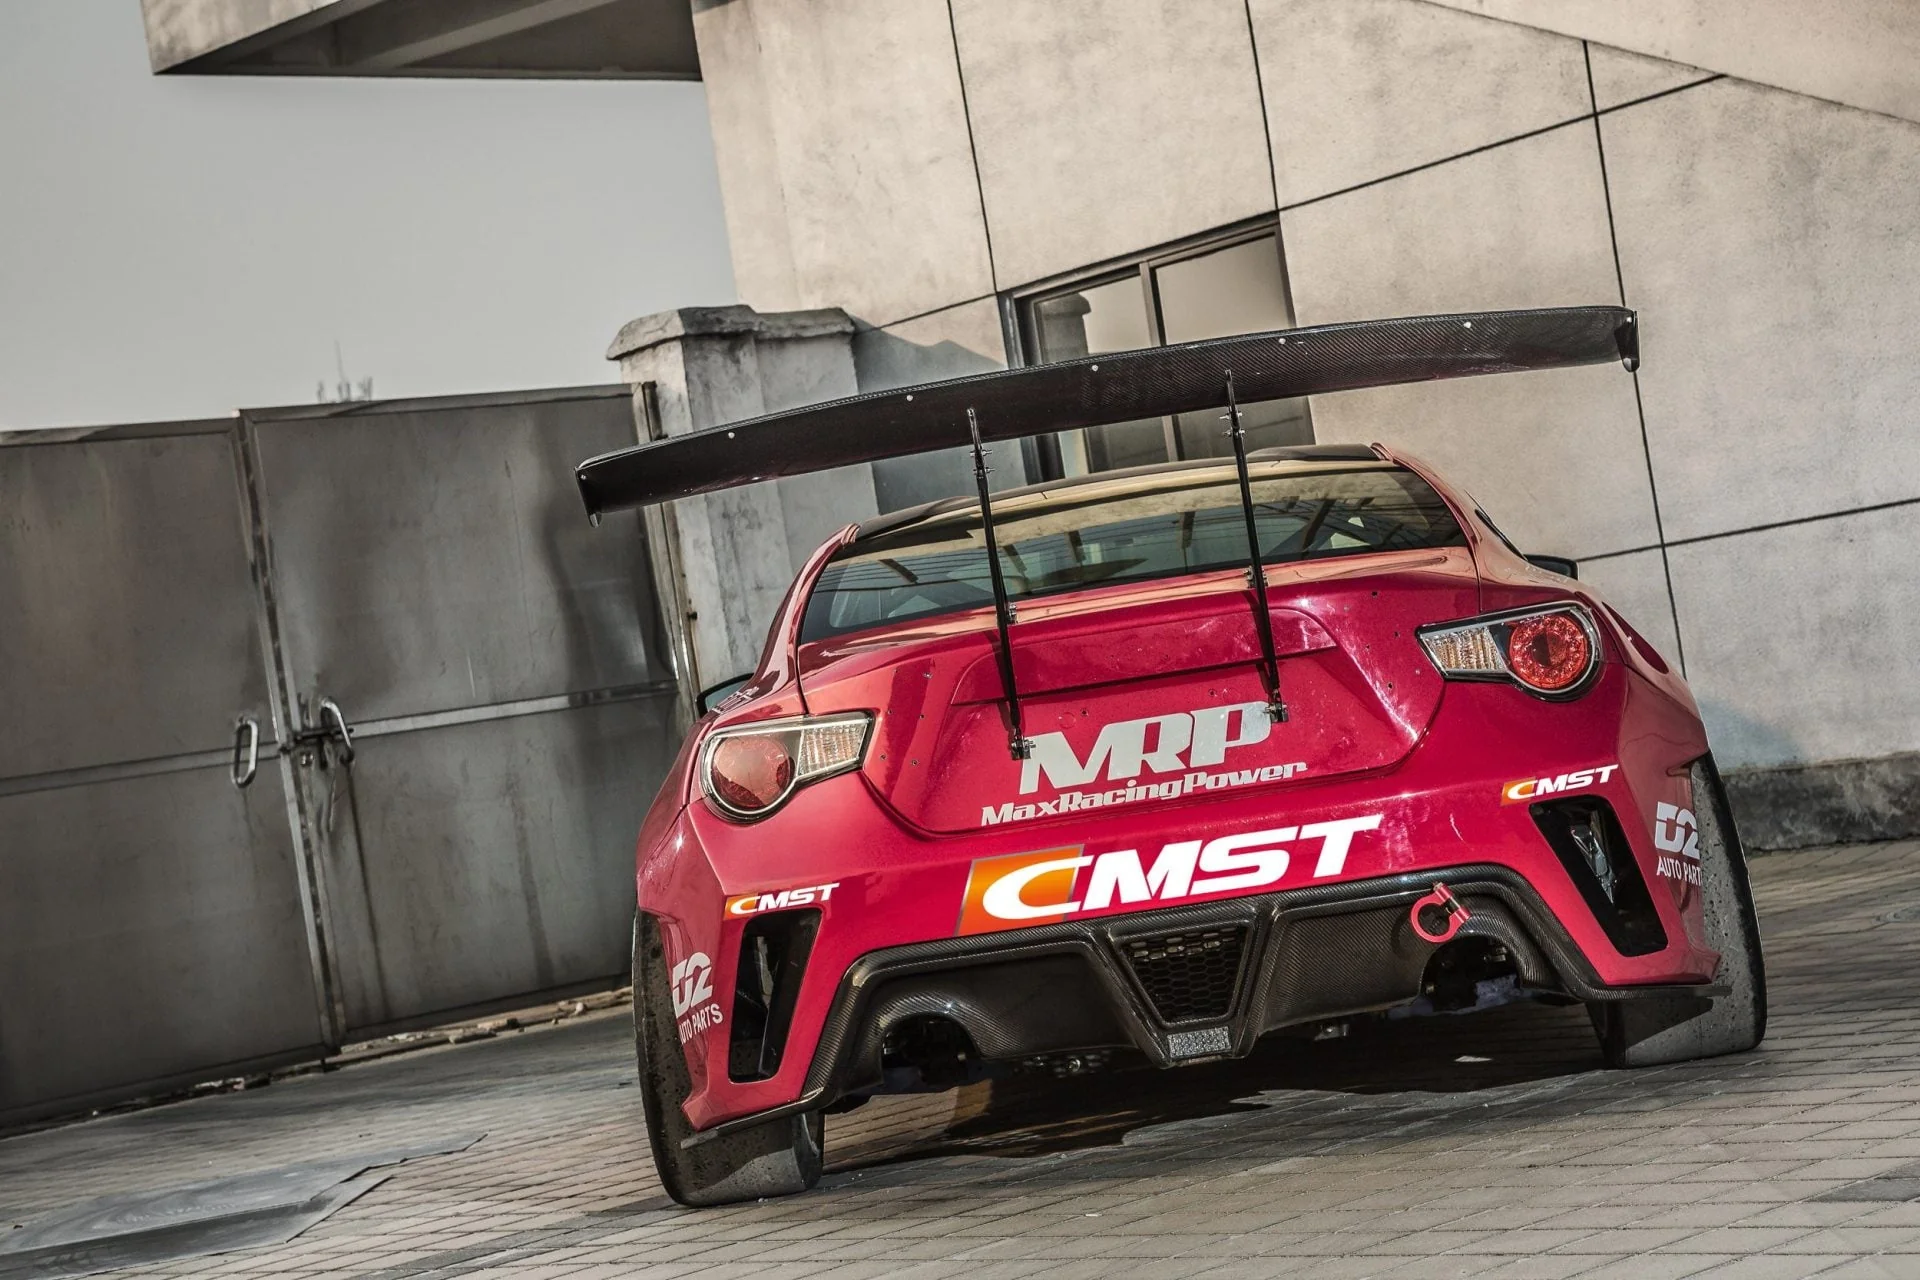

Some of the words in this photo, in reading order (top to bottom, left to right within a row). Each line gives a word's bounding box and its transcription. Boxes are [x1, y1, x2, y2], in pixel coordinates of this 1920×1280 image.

[1019, 701, 1272, 795] MRP
[1506, 764, 1619, 800] CMST
[982, 814, 1383, 920] CMST
[1656, 856, 1682, 880] AUTO
[1683, 862, 1702, 886] PART
[730, 883, 840, 914] CMST
[692, 1003, 723, 1035] PARTS
